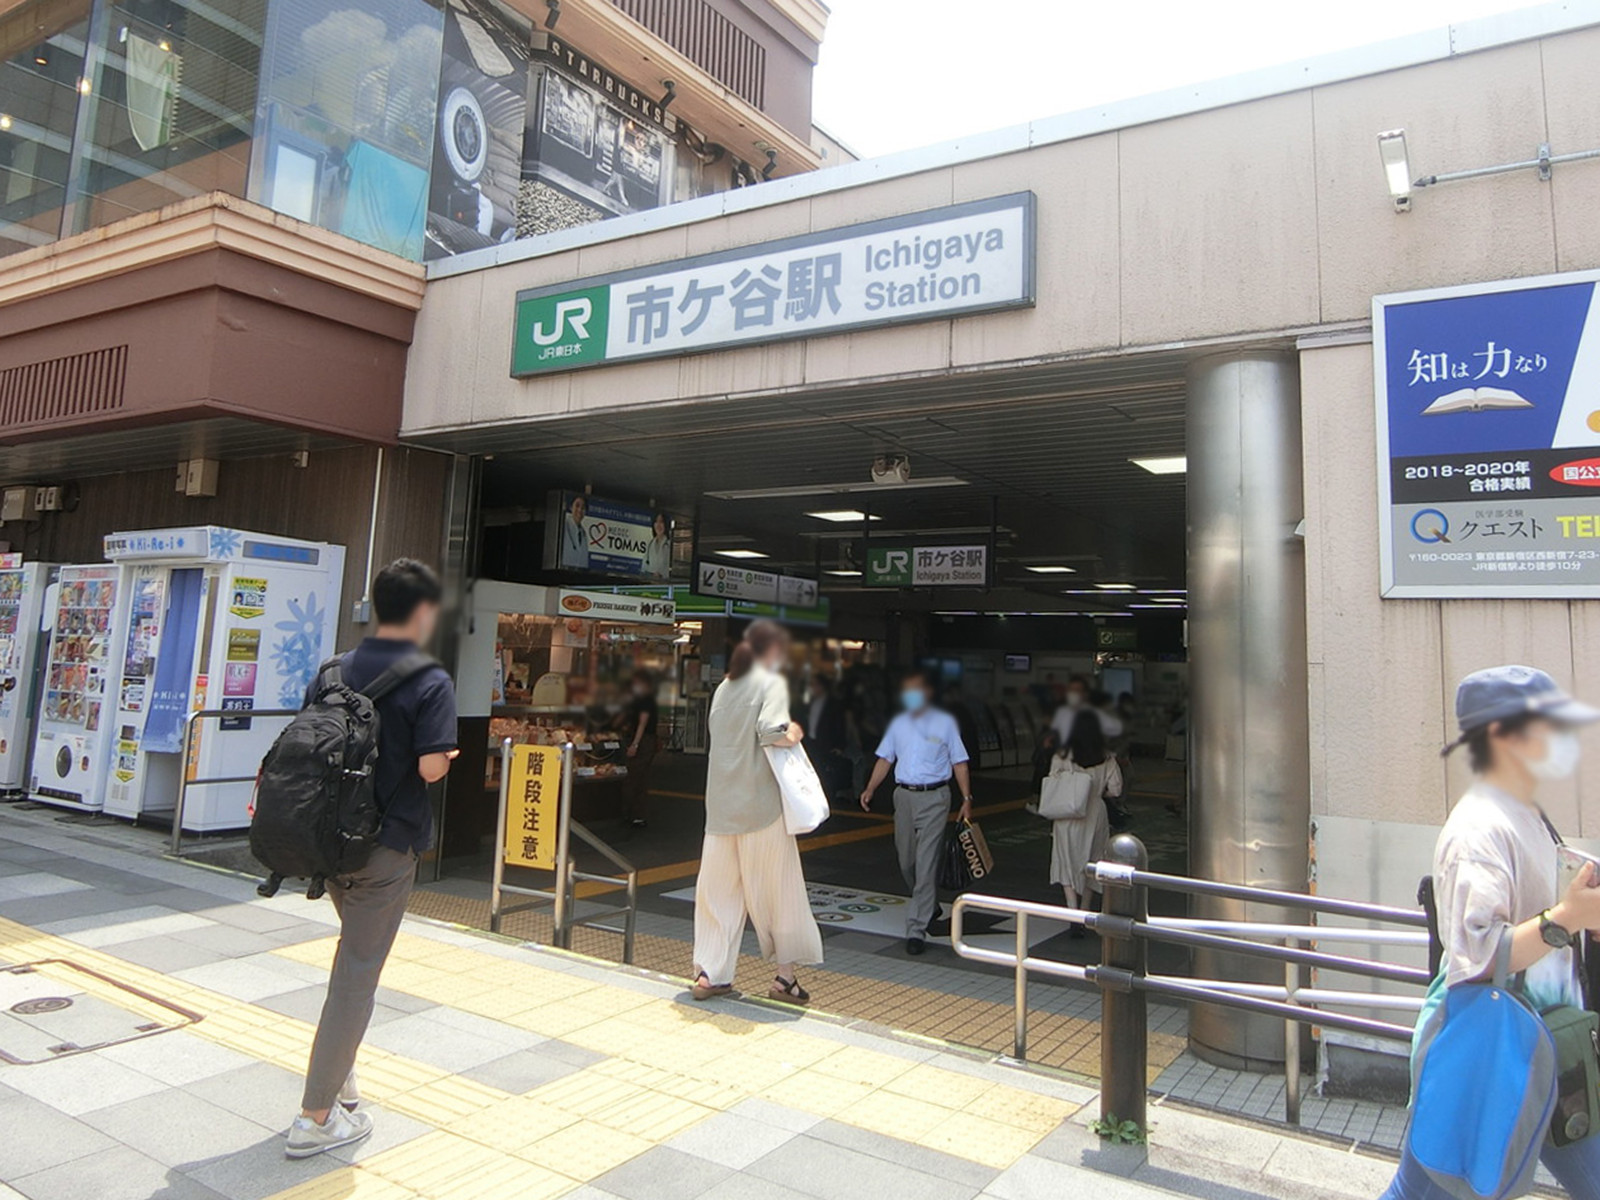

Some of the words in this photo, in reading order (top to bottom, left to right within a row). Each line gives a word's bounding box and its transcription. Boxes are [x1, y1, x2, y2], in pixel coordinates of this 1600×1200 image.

[551, 41, 661, 124] STARBUCKS
[865, 228, 1004, 272] Ichigaya
[864, 272, 981, 311] Station
[533, 297, 592, 346] JR
[538, 343, 582, 360] JR東日本
[1407, 341, 1549, 387] 知は力なり
[1469, 477, 1532, 493] 合格実績
[607, 535, 647, 554] TOMAS
[1459, 518, 1543, 542] クエスト
[872, 551, 909, 574] JR
[916, 570, 950, 582] Ichigaya
[952, 570, 982, 580] Station
[521, 751, 545, 861] 階段注意
[958, 828, 985, 879] BUONO
